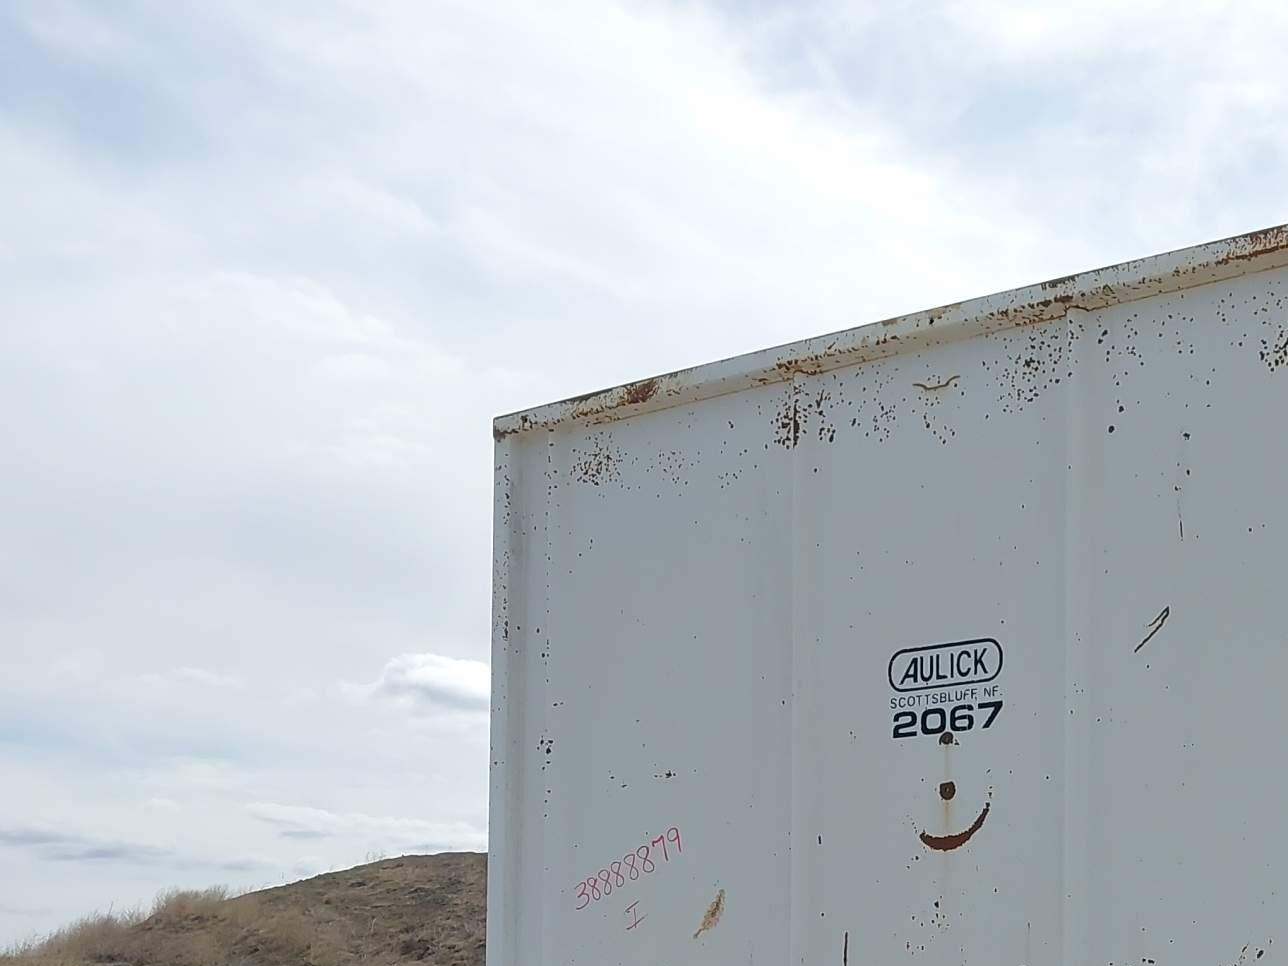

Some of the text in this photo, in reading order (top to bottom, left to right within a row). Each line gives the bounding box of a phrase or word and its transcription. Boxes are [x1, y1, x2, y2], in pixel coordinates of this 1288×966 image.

[899, 648, 989, 685] AULICK
[893, 701, 1003, 738] 2067
[574, 827, 682, 910] 38888879
